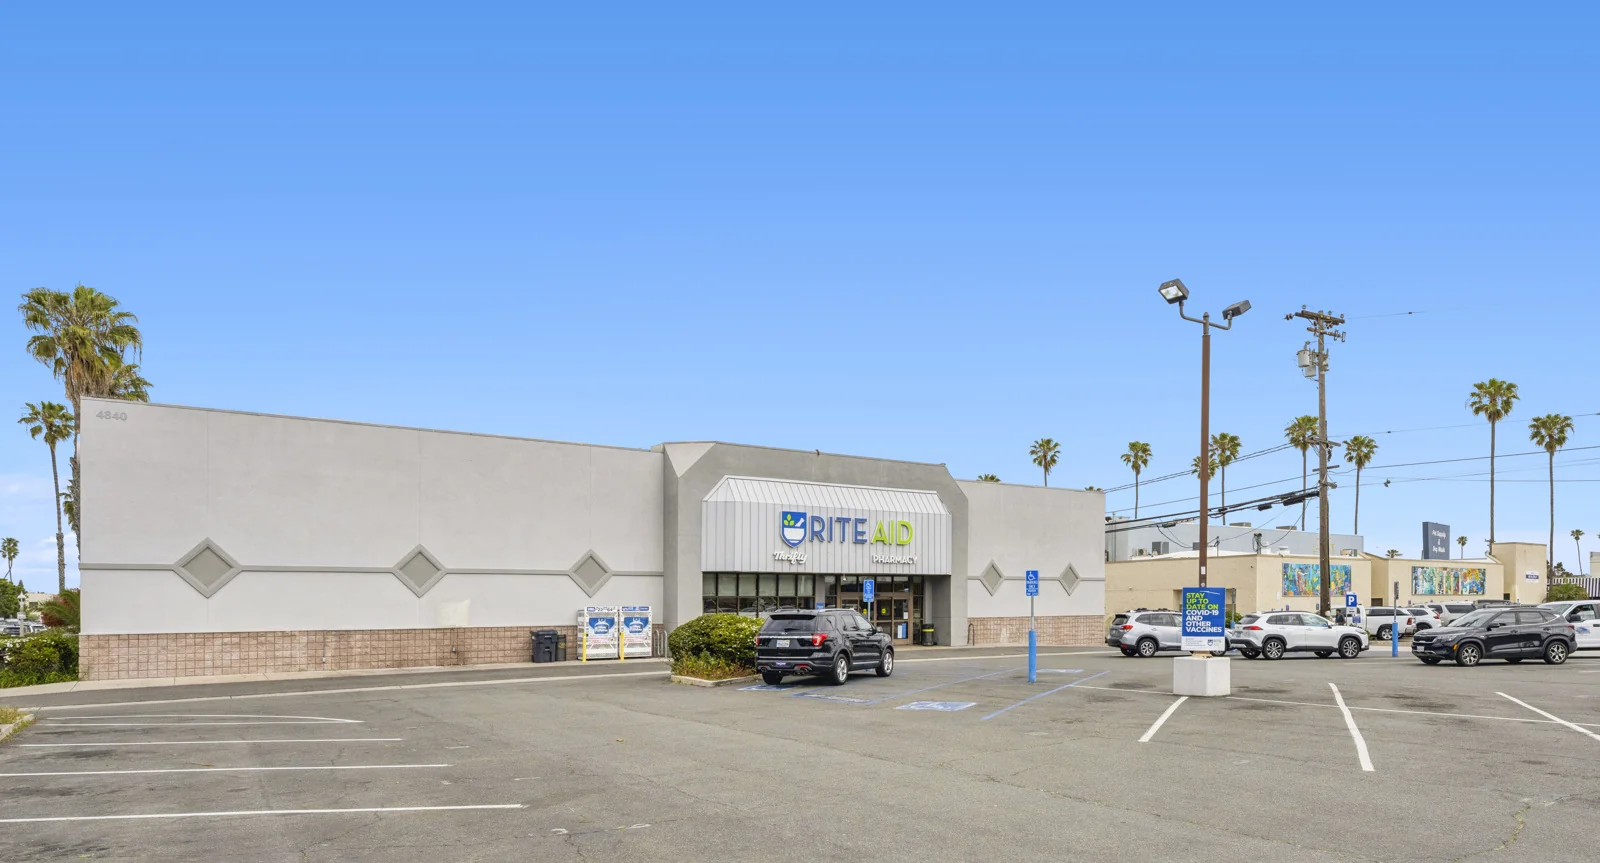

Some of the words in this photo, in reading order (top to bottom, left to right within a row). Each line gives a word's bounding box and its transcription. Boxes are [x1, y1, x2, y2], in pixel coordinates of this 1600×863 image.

[95, 410, 128, 421] 4840
[809, 515, 868, 544] RITE
[871, 519, 914, 546] AID
[772, 551, 808, 565] Thrifty
[872, 554, 918, 565] PHARMACY
[1348, 595, 1355, 606] P
